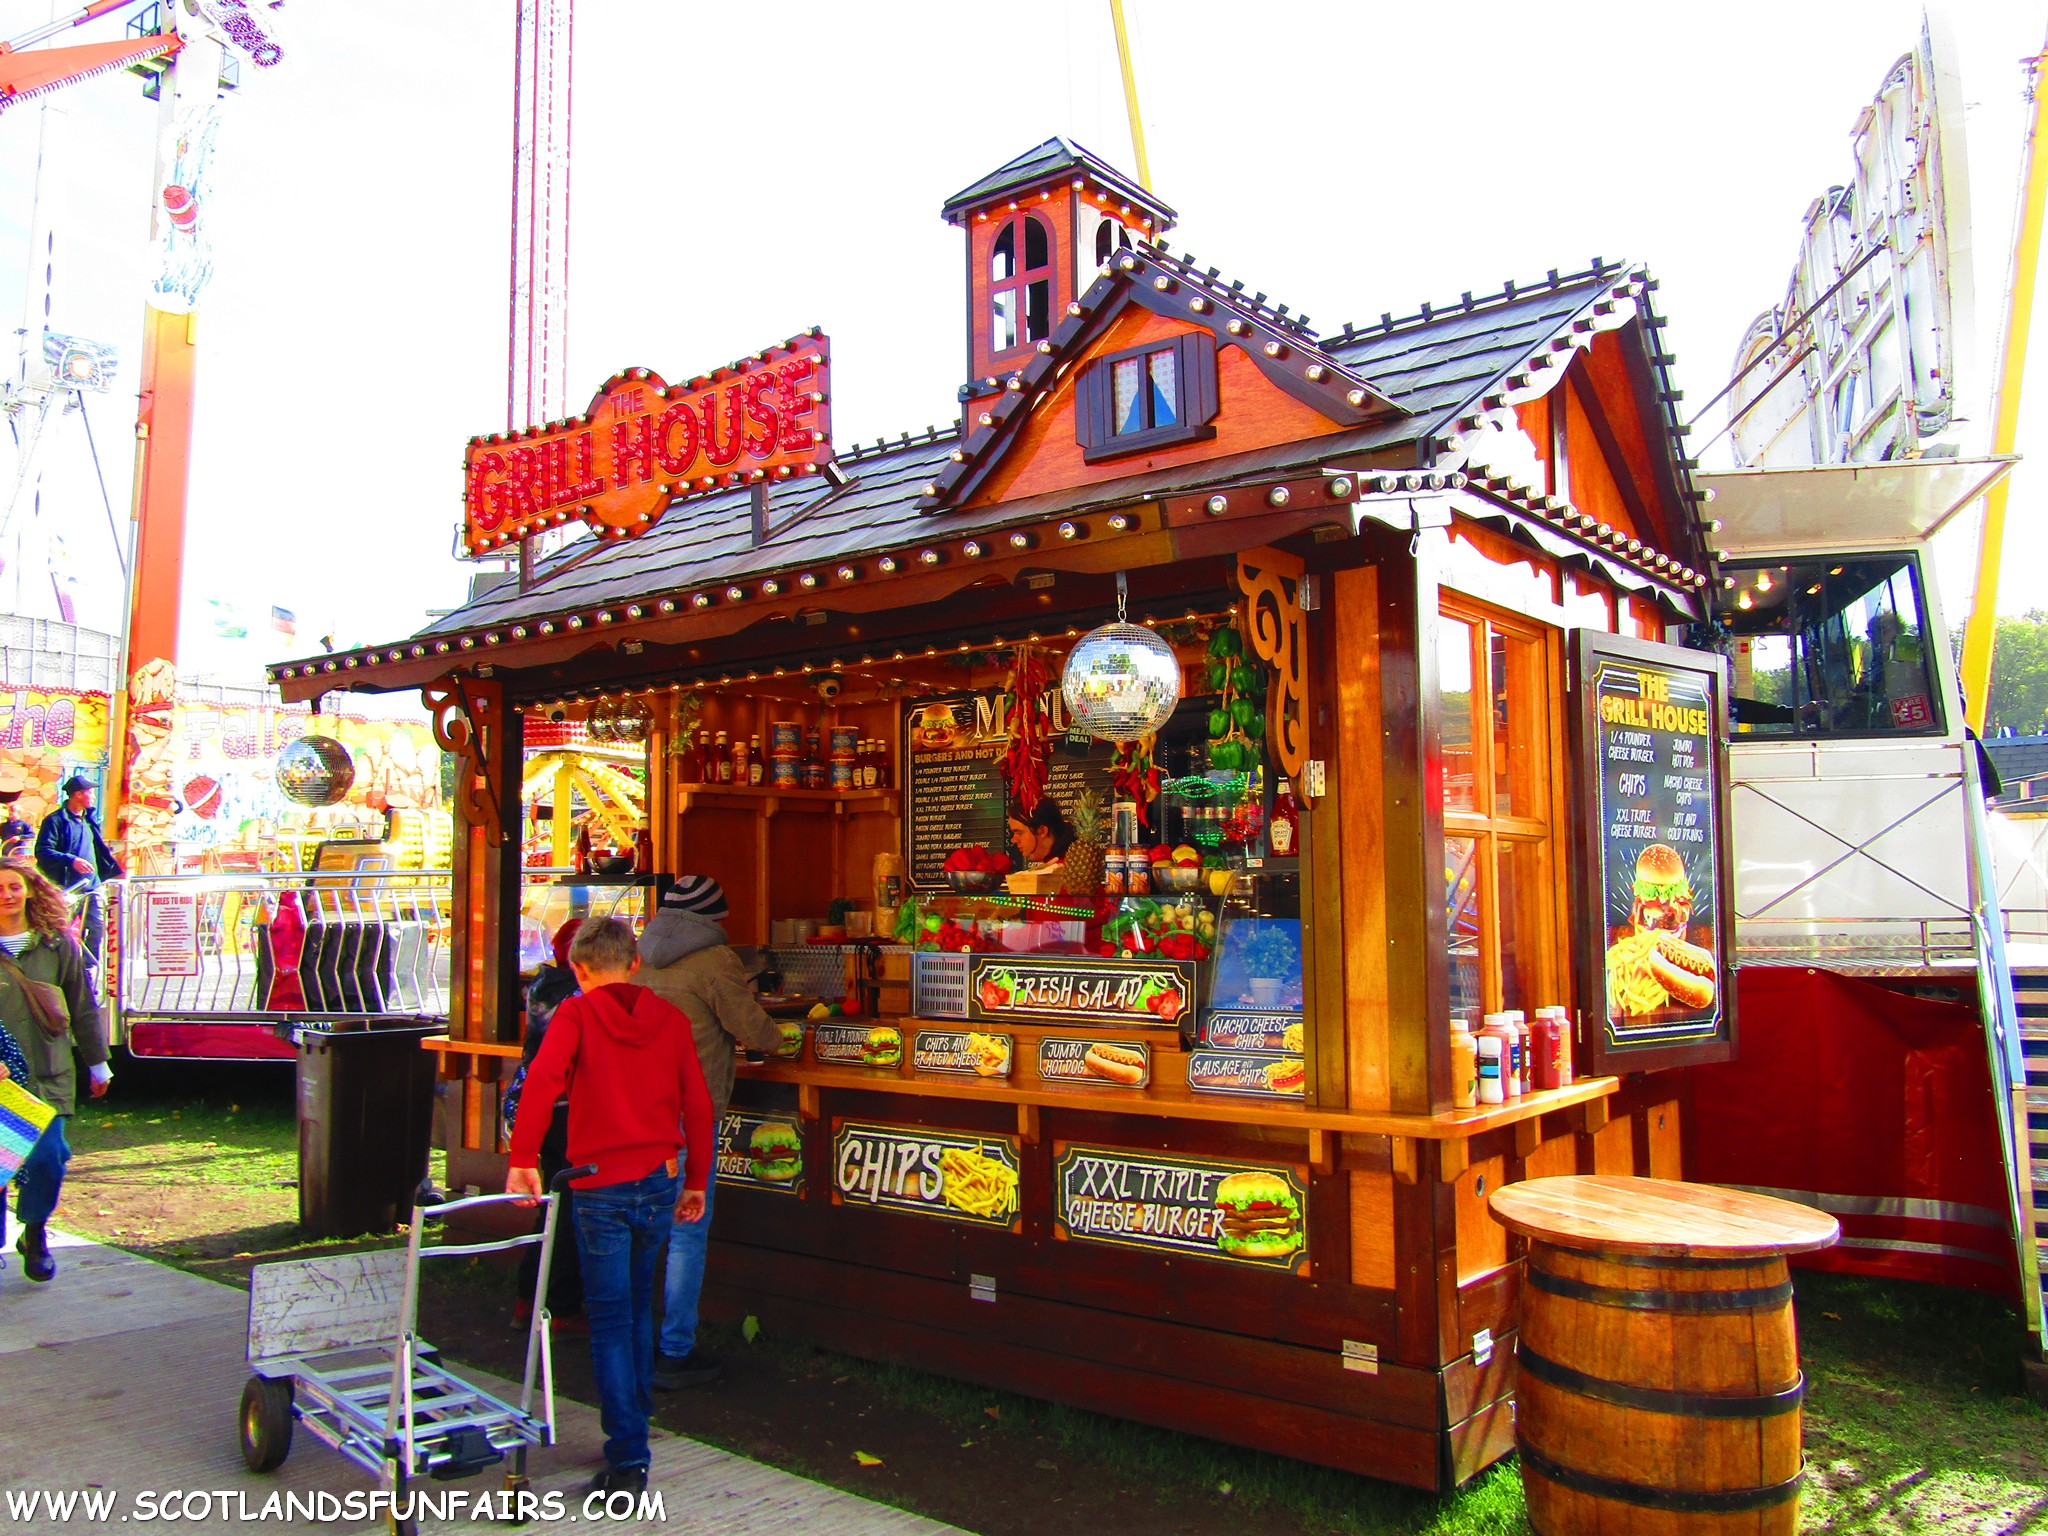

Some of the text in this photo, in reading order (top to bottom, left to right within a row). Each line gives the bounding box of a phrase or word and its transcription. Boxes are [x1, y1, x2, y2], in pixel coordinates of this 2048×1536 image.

[608, 387, 644, 419] THE
[468, 356, 815, 533] GRILL HOUSE
[1636, 672, 1669, 702] THE
[1601, 695, 1707, 736] GRILL HOUSE
[1069, 735, 1089, 743] DEAL
[1624, 732, 1652, 747] POUNDER
[1672, 738, 1693, 753] JUMBO
[915, 751, 953, 764] BURGERS
[954, 751, 974, 761] AND
[975, 748, 994, 759] HOT
[1608, 746, 1654, 763] CHEESE BURGER
[1618, 772, 1646, 797] CHIPS
[1663, 775, 1703, 791] NACHO CHEESE
[1675, 791, 1692, 806] CHIPS
[1616, 808, 1651, 823] XXL TRIPLE
[1673, 812, 1697, 826] HOT AND
[1610, 823, 1657, 839] CHEESE BURGER
[1667, 827, 1704, 843] COLD DRINKS
[152, 897, 170, 905] RULES
[179, 896, 193, 904] RIDE
[1010, 976, 1143, 1009] FRESH SALAD
[1213, 1017, 1289, 1034] NACHO CHEESE
[925, 1037, 972, 1051] CHIPS AND
[1233, 1034, 1265, 1049] CHIPS
[914, 1051, 981, 1067] GRATED CHEESE
[1047, 1043, 1083, 1059] JUMBO
[1193, 1060, 1240, 1077] SAUSAGE
[1237, 1068, 1268, 1084] CHIPS
[838, 1139, 944, 1203] CHIPS
[1079, 1160, 1213, 1202] XXL TRIPLE
[1068, 1199, 1229, 1240] CHEESE BURGER
